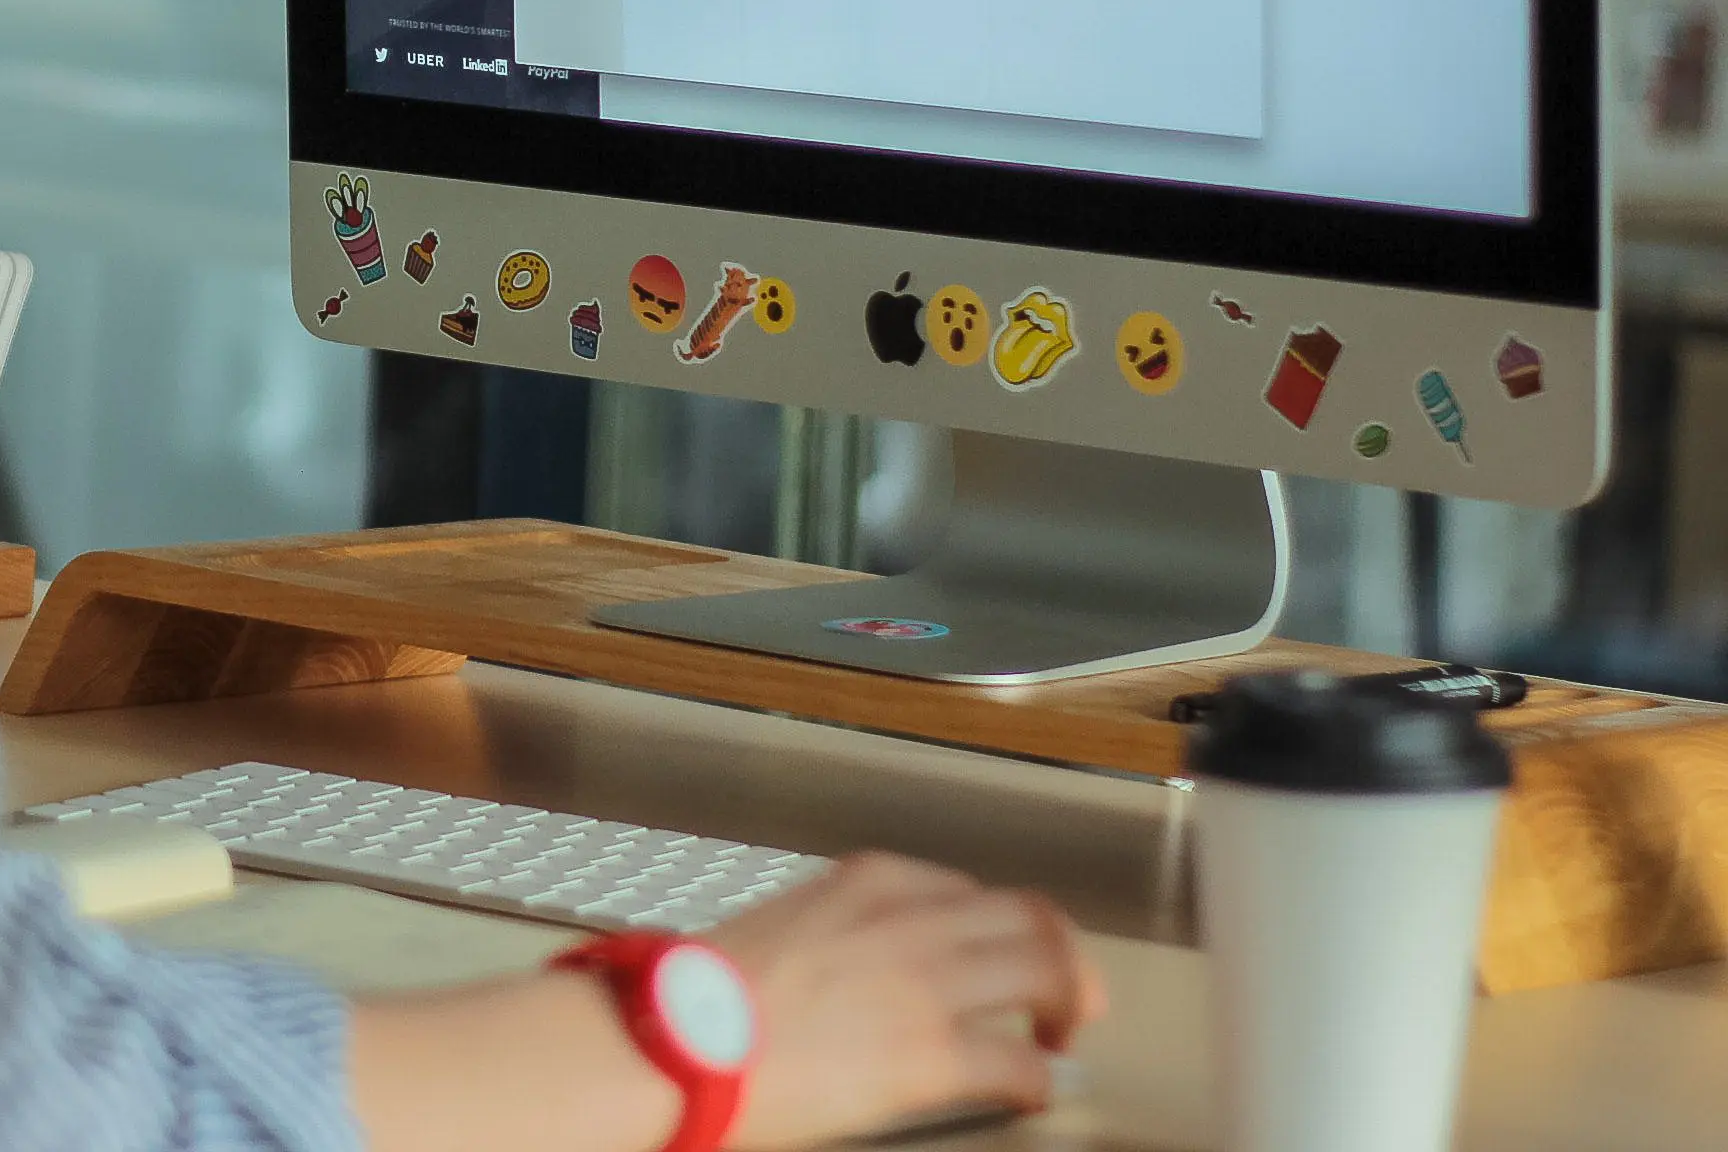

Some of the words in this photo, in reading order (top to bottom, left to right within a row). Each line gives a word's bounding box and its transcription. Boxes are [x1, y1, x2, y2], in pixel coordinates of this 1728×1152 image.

[388, 18, 418, 30] TRUSTED
[419, 20, 429, 30] BY
[430, 21, 444, 31] THE
[445, 23, 476, 35] WORLD'S
[407, 51, 444, 68] UBER
[528, 65, 569, 80] PayPal
